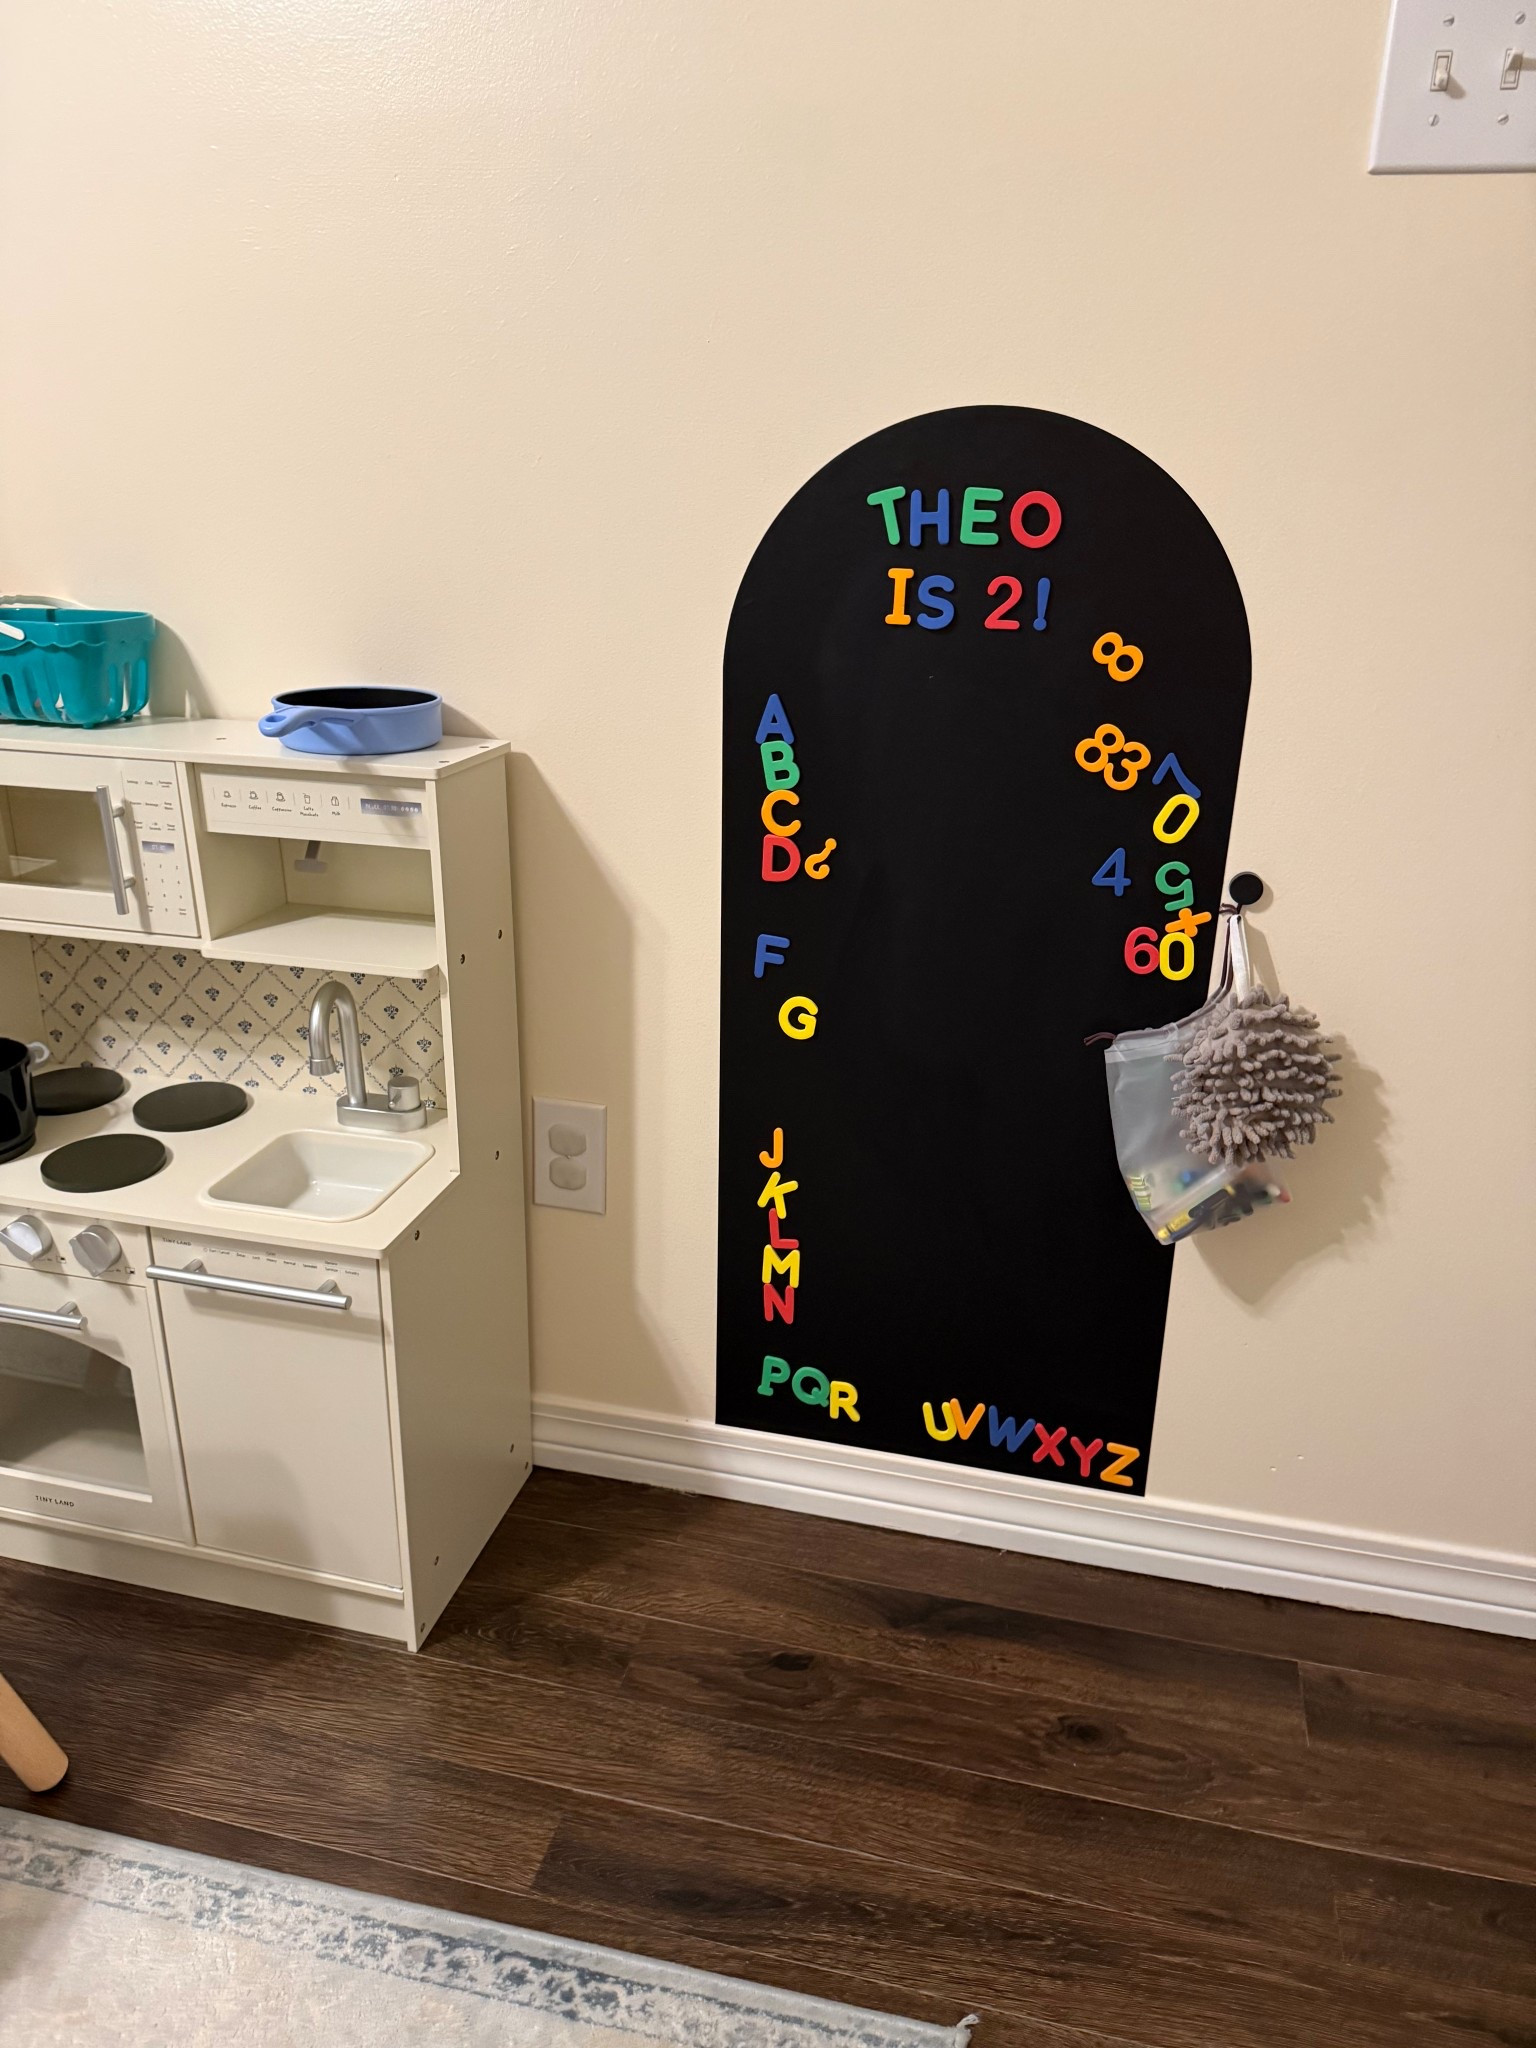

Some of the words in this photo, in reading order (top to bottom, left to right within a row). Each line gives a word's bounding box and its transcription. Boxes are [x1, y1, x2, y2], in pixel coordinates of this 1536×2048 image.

[867, 486, 1062, 548] THEO
[885, 567, 955, 630] IS
[1092, 631, 1144, 682] 8
[1091, 847, 1131, 897] 4
[754, 933, 791, 978] F
[778, 995, 819, 1040] G
[757, 1355, 861, 1422] PQR
[35, 1495, 52, 1503] TINY
[54, 1498, 75, 1507] LAND
